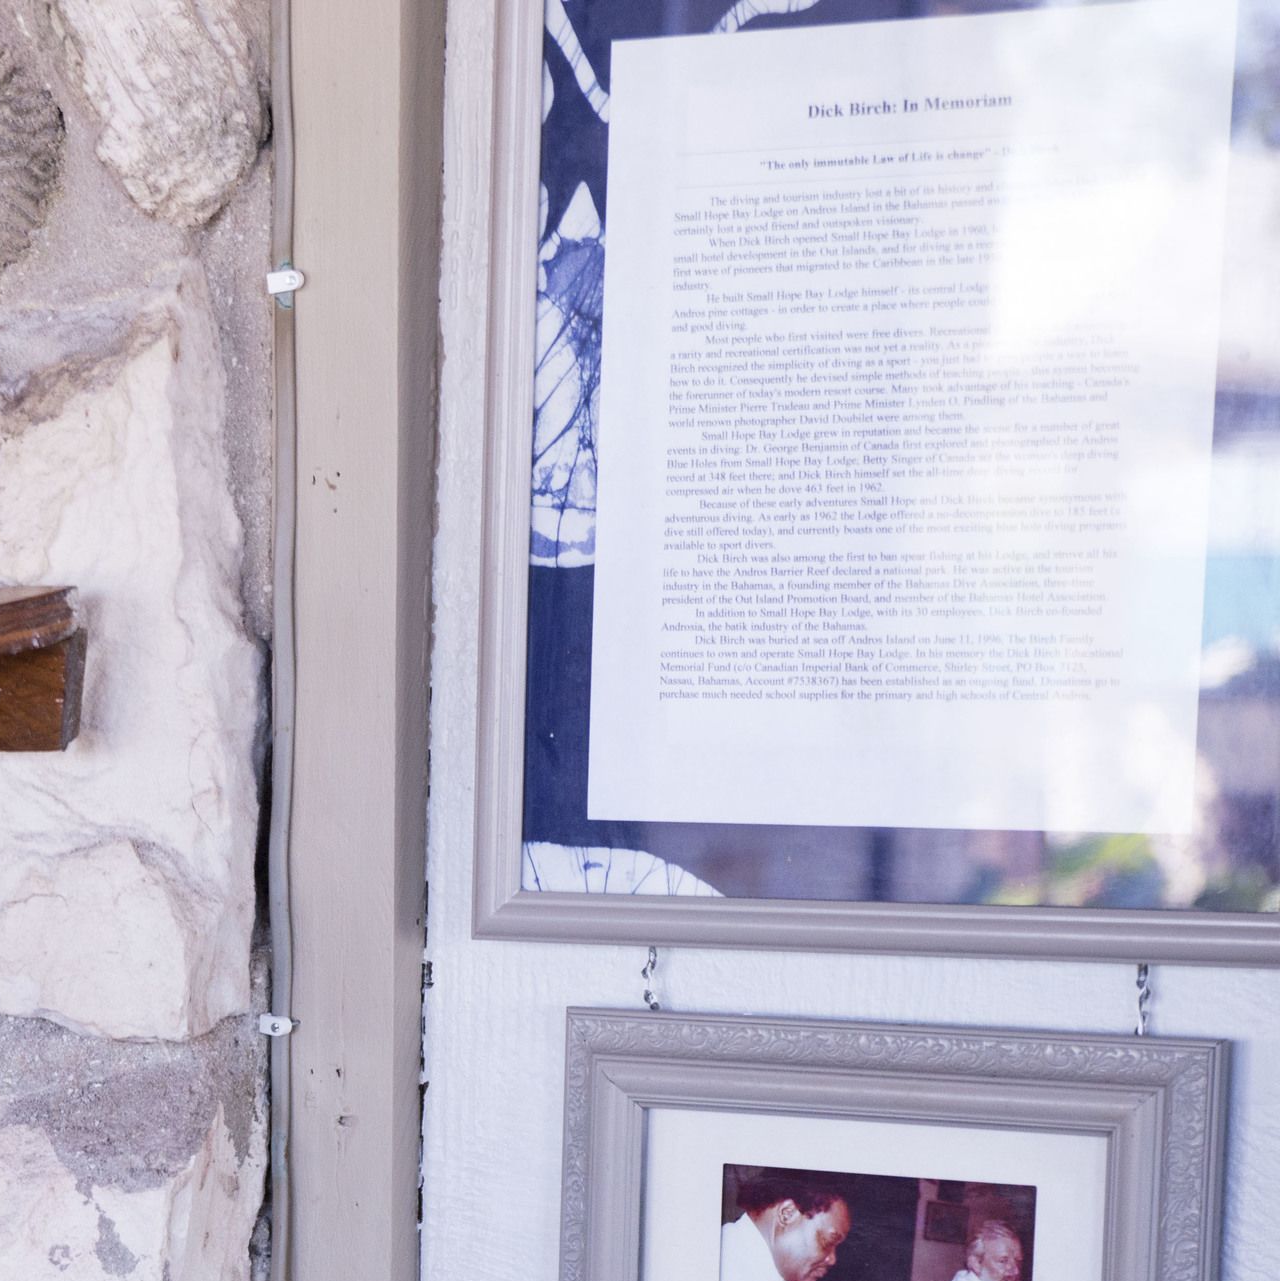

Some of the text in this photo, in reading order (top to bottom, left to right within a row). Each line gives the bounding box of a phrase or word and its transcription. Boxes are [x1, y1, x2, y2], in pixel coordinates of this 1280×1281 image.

[808, 93, 1013, 119] Dick Birch: In Memoriam
[789, 151, 944, 170] only immutable Law of Life is
[666, 488, 719, 497] compressed
[722, 487, 734, 495] air
[737, 486, 762, 495] when
[765, 485, 776, 494] he
[779, 485, 801, 494] dove
[826, 484, 844, 493] feet
[847, 484, 856, 492] in
